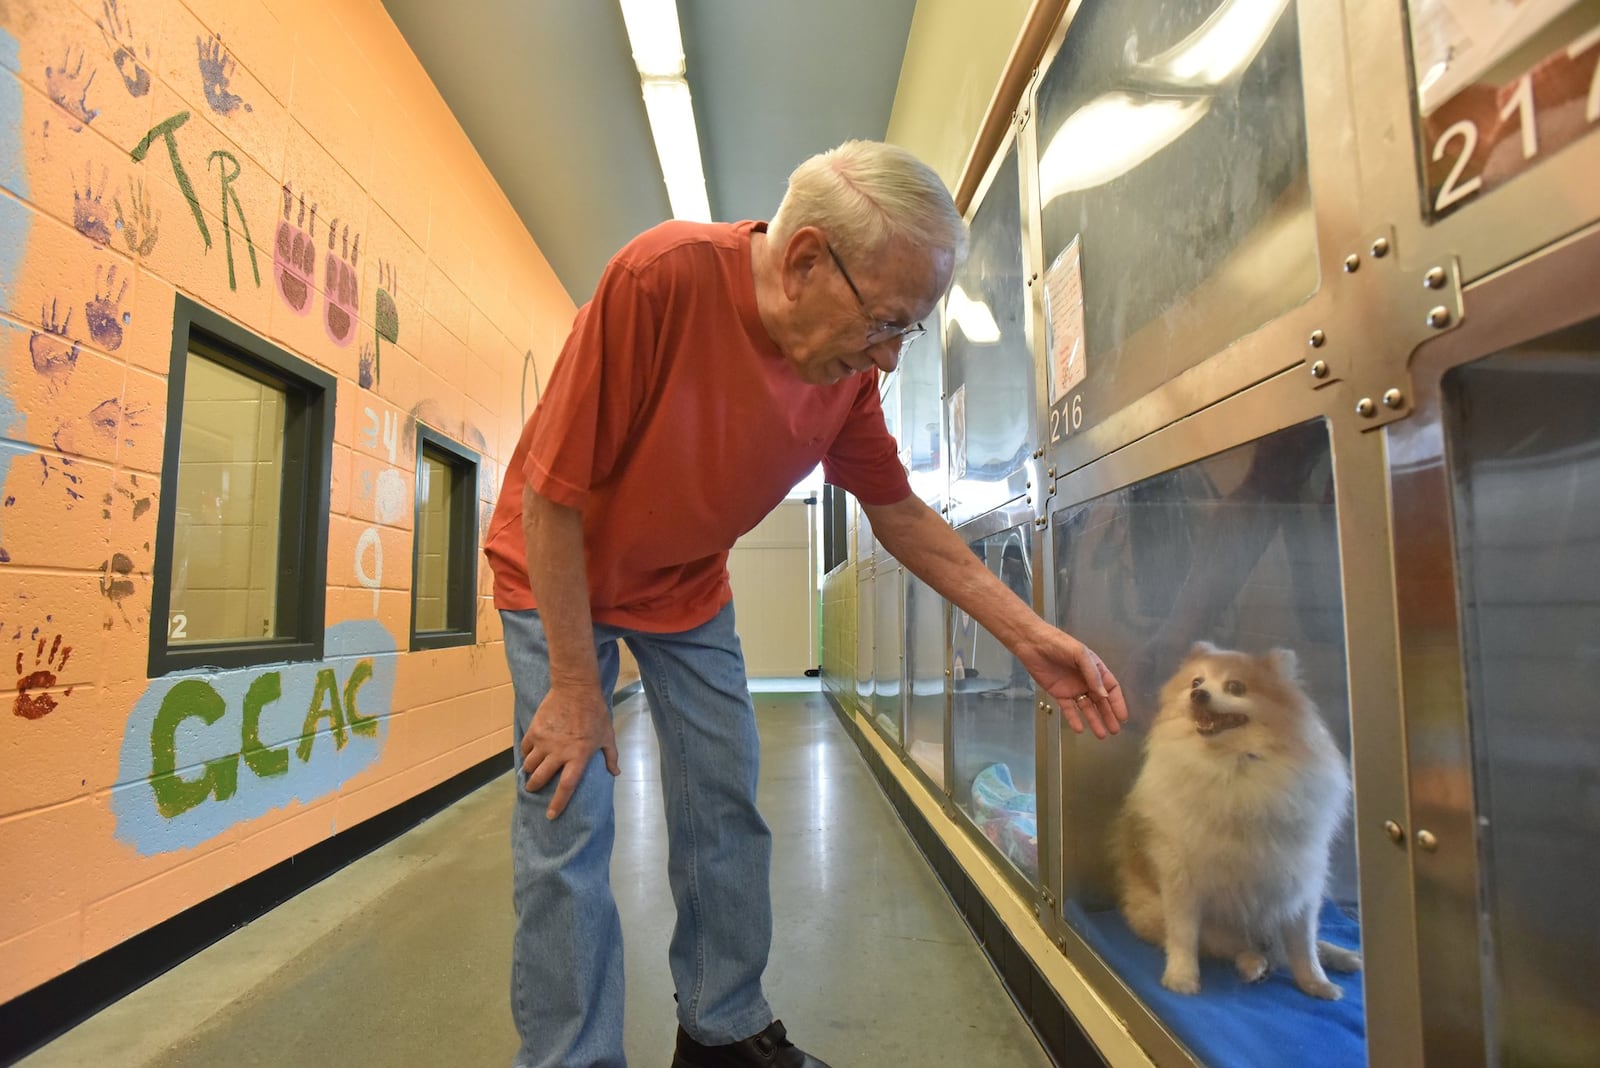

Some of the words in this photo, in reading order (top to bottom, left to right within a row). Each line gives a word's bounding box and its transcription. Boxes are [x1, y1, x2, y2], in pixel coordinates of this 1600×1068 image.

[1051, 394, 1083, 443] 216
[168, 614, 188, 638] 2
[149, 657, 379, 819] GCAC
